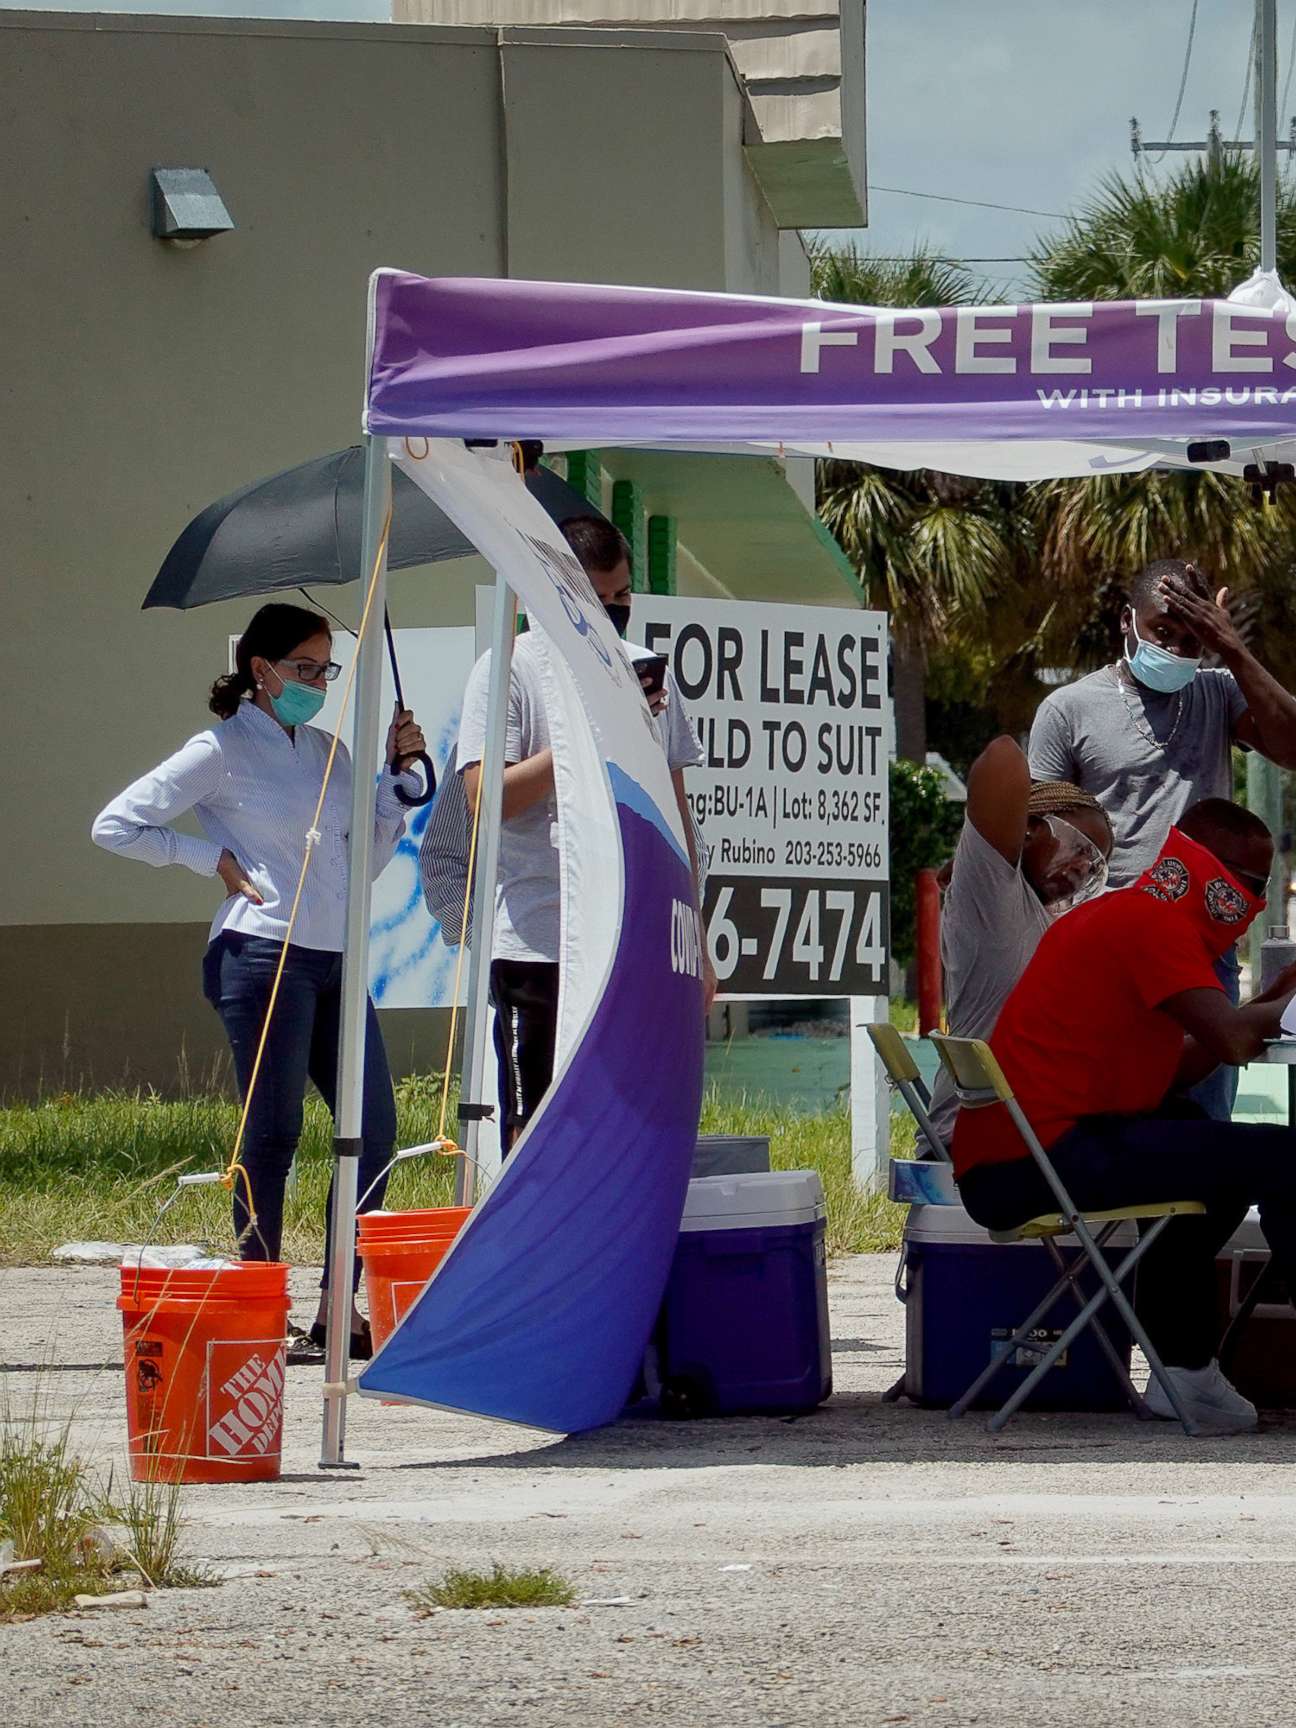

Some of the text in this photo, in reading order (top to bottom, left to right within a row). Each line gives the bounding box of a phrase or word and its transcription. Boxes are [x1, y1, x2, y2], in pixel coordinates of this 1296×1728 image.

[800, 302, 1093, 374] FREE
[1036, 388, 1142, 409] WITH
[645, 622, 743, 701] FOR
[760, 629, 881, 709] LEASE
[762, 720, 807, 773] TO
[817, 722, 882, 776] SUIT
[782, 787, 812, 820] Lot:
[818, 788, 859, 826] 8,362
[721, 837, 776, 865] Rubino
[785, 839, 881, 868] 203-253-5966
[706, 887, 886, 982] 6-7474
[220, 1353, 266, 1400] THE
